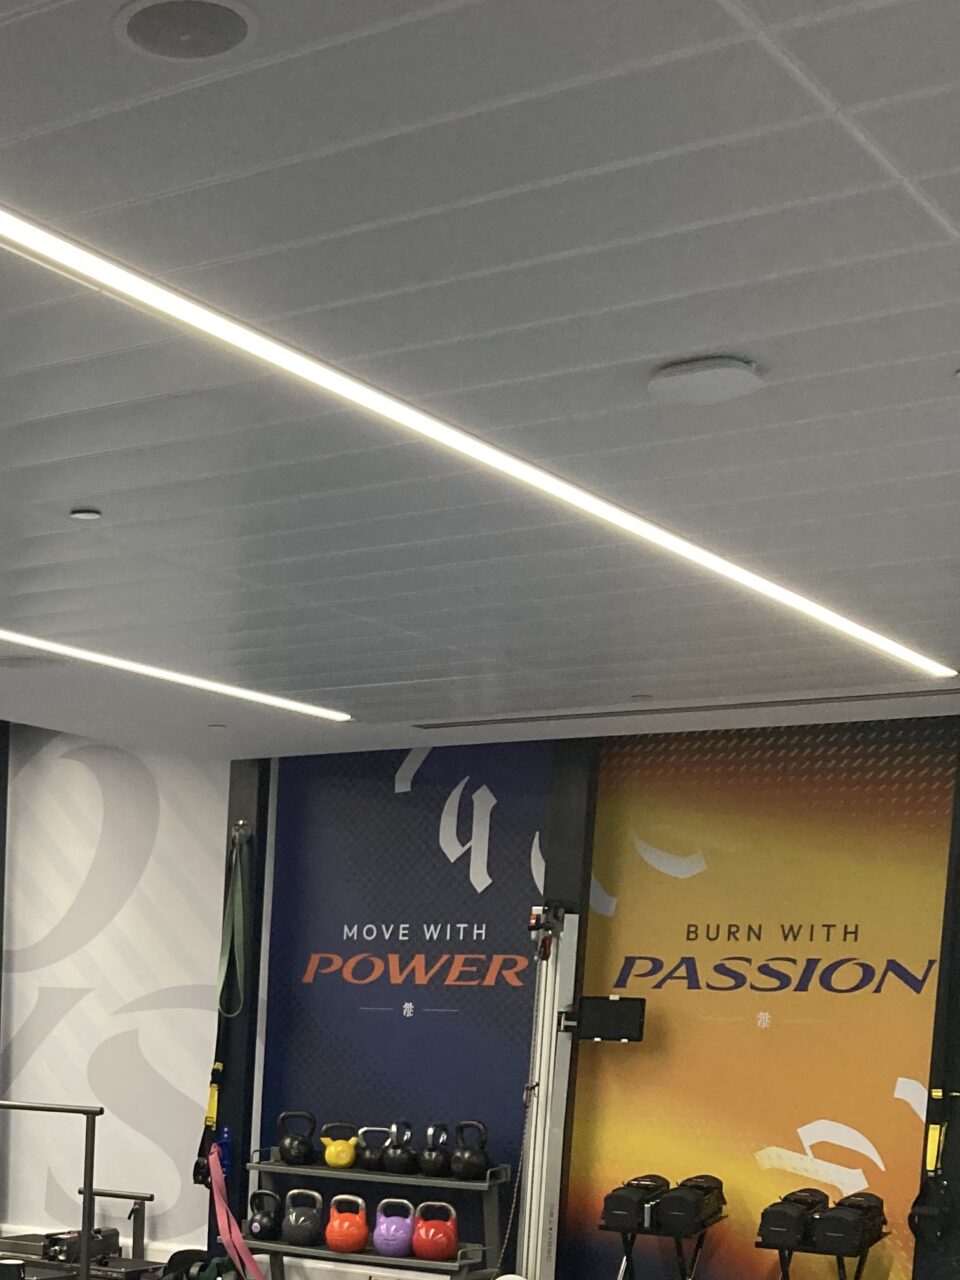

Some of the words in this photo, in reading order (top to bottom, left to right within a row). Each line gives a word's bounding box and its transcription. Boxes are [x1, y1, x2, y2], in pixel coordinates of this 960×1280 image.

[343, 924, 410, 941] MOVE
[424, 924, 487, 941] WITH
[686, 924, 763, 942] BURN
[781, 924, 860, 942] WITH
[302, 953, 529, 987] POWER
[612, 956, 938, 995] PASSION
